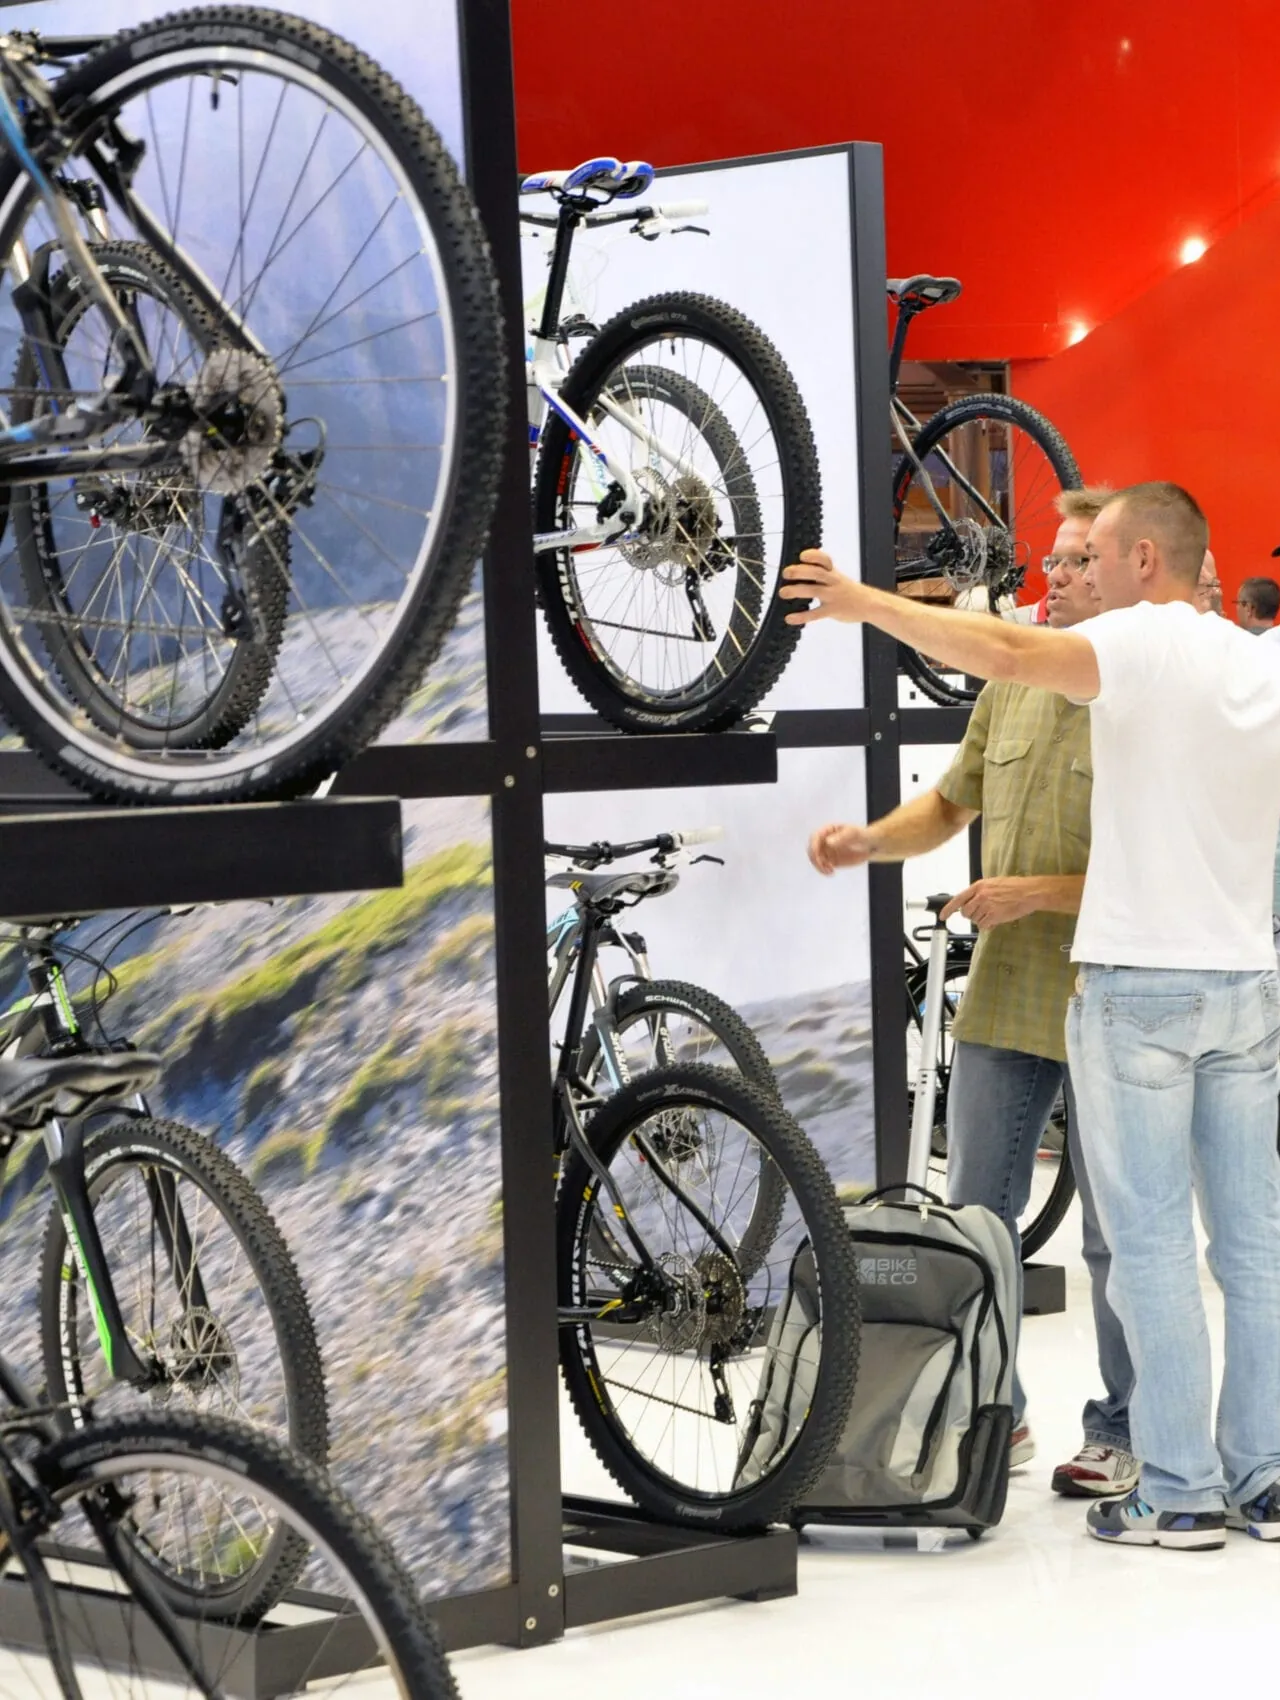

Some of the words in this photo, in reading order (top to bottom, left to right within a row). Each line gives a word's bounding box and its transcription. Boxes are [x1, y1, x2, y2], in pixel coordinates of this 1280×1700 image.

[645, 995, 711, 1023] SCHWALBE
[877, 1259, 917, 1271] BIKE
[877, 1273, 887, 1285] &
[890, 1272, 917, 1285] CO
